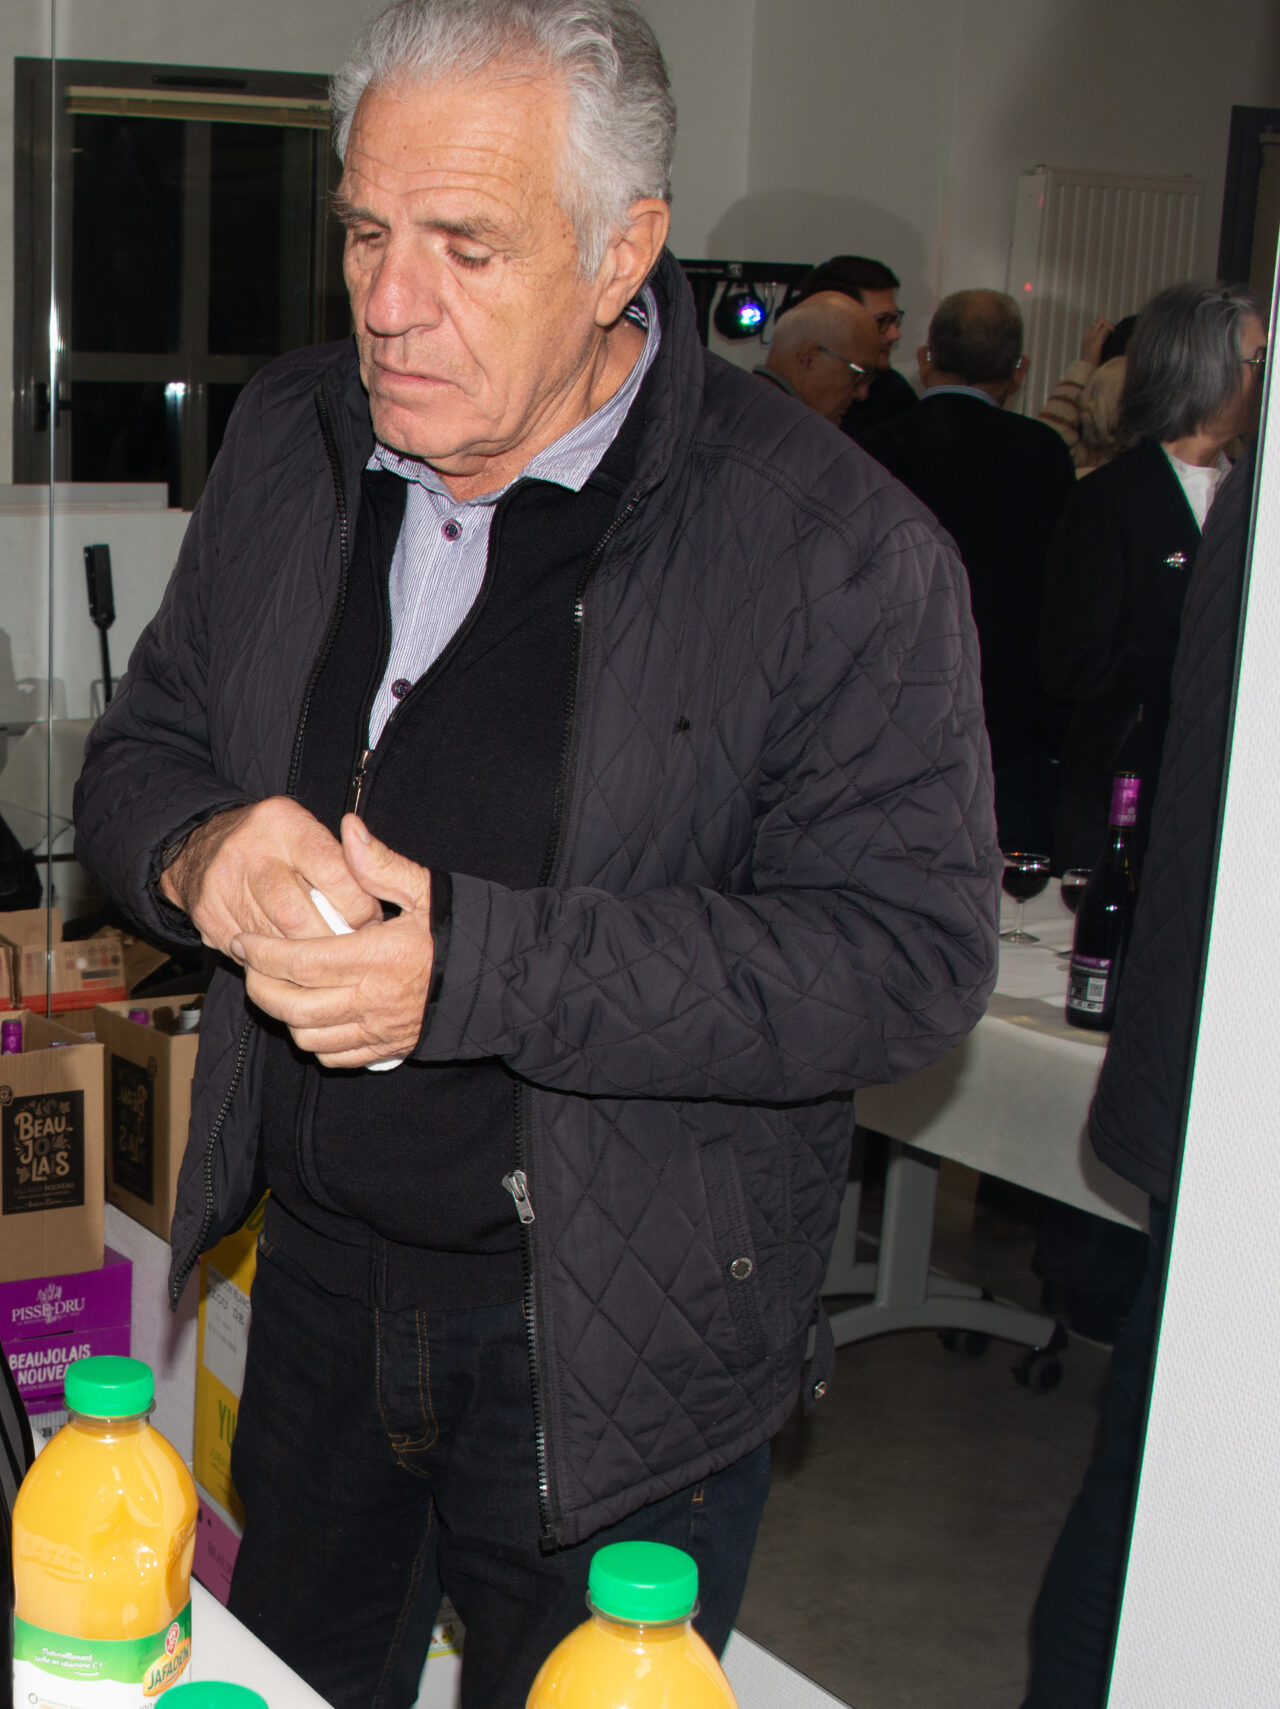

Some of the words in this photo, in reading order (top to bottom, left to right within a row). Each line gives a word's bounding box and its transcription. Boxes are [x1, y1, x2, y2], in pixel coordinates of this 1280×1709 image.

[11, 1297, 86, 1322] PISSE-DRU
[8, 1344, 92, 1371] BEAUJOLAIS
[147, 1645, 189, 1690] JAFADEN
